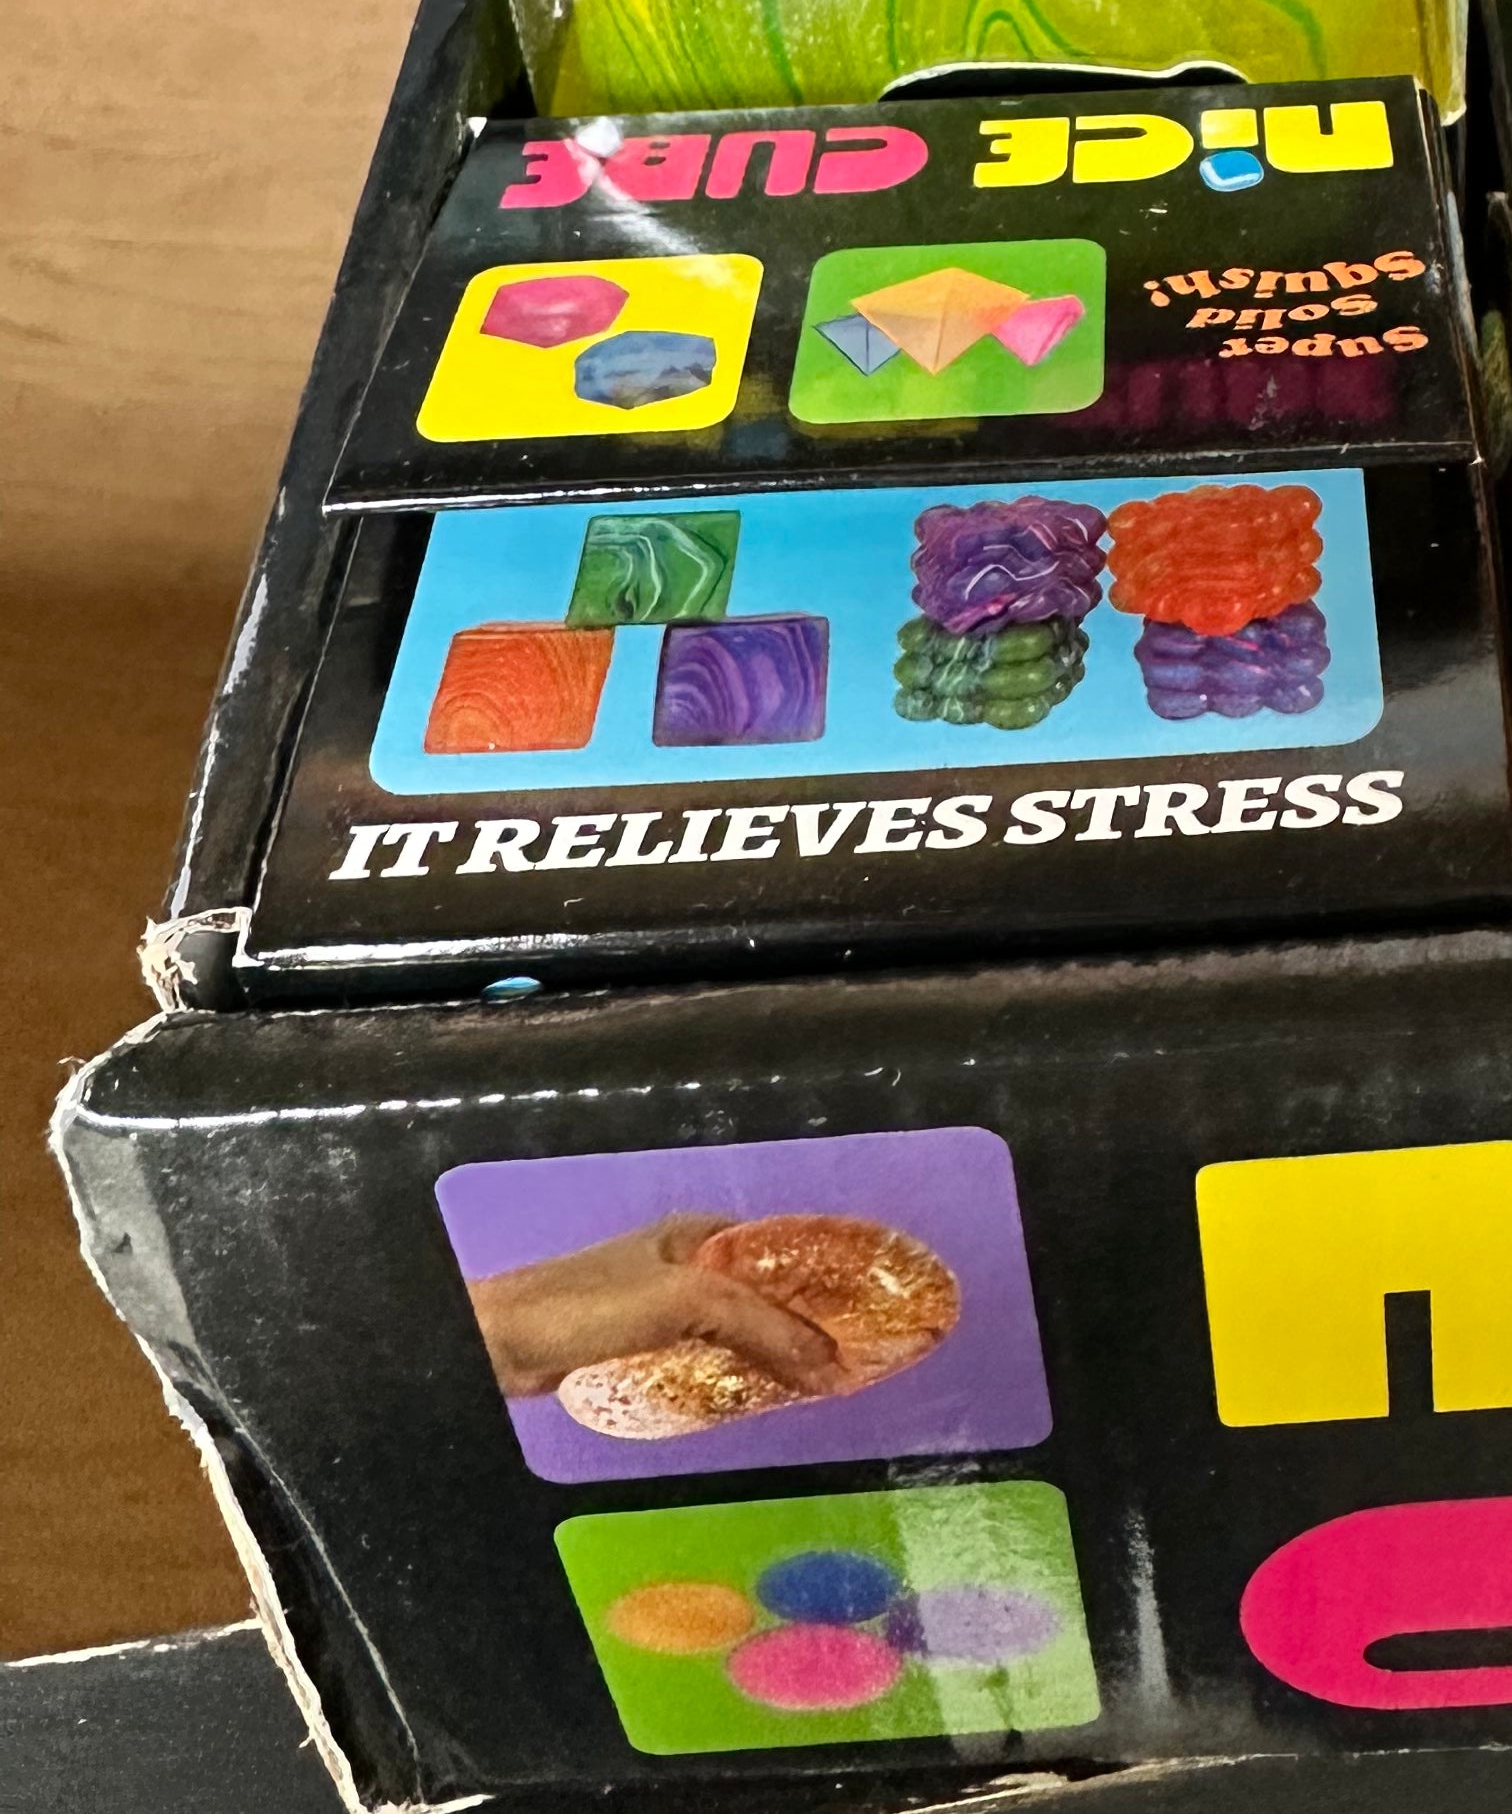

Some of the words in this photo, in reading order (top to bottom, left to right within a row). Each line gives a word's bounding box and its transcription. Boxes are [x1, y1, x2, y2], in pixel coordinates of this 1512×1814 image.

[499, 125, 930, 209] CUBE
[1143, 250, 1427, 308] Squish!
[1184, 293, 1379, 331] Solid
[1217, 325, 1430, 358] Super
[328, 820, 459, 881] IT
[455, 794, 994, 876] RELIEVES
[1002, 770, 1406, 846] STRESS
